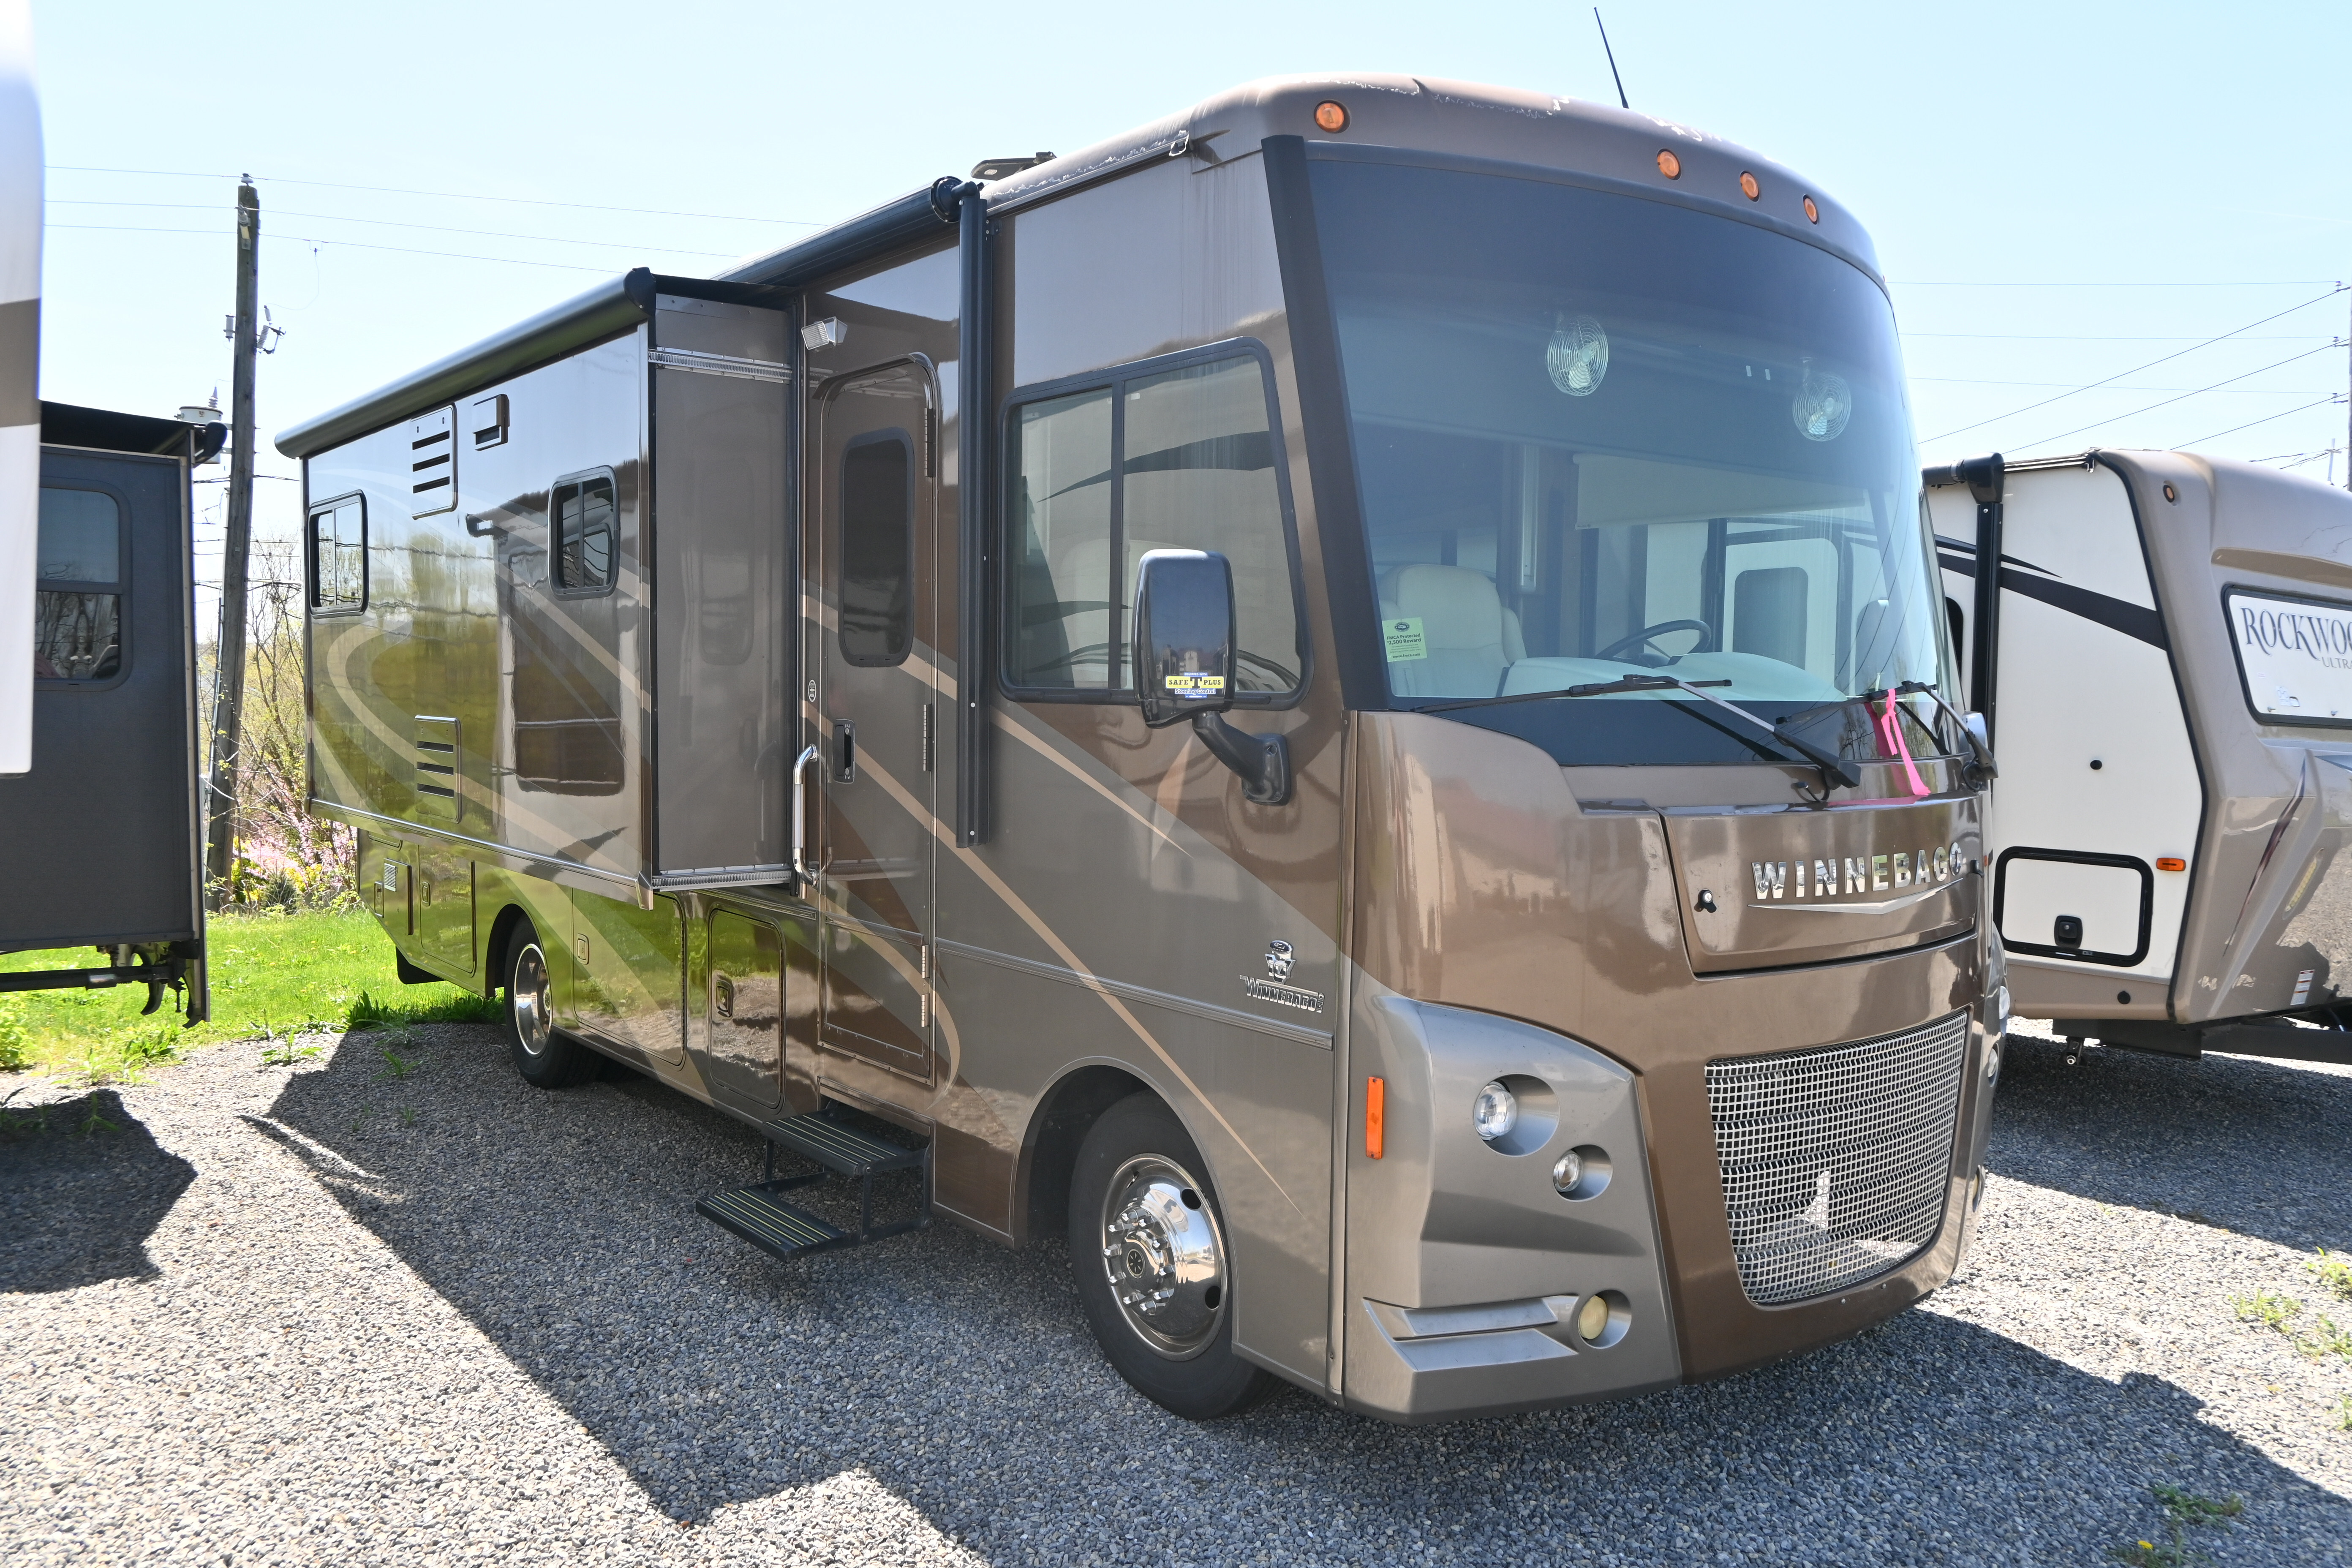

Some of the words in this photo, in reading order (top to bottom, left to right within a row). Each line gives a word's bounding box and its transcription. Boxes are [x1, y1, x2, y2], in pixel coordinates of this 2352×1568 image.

[1190, 677, 1202, 689] T
[1751, 842, 1962, 899] WINNEBAGO
[1239, 975, 1317, 1012] WINNEBAGO
